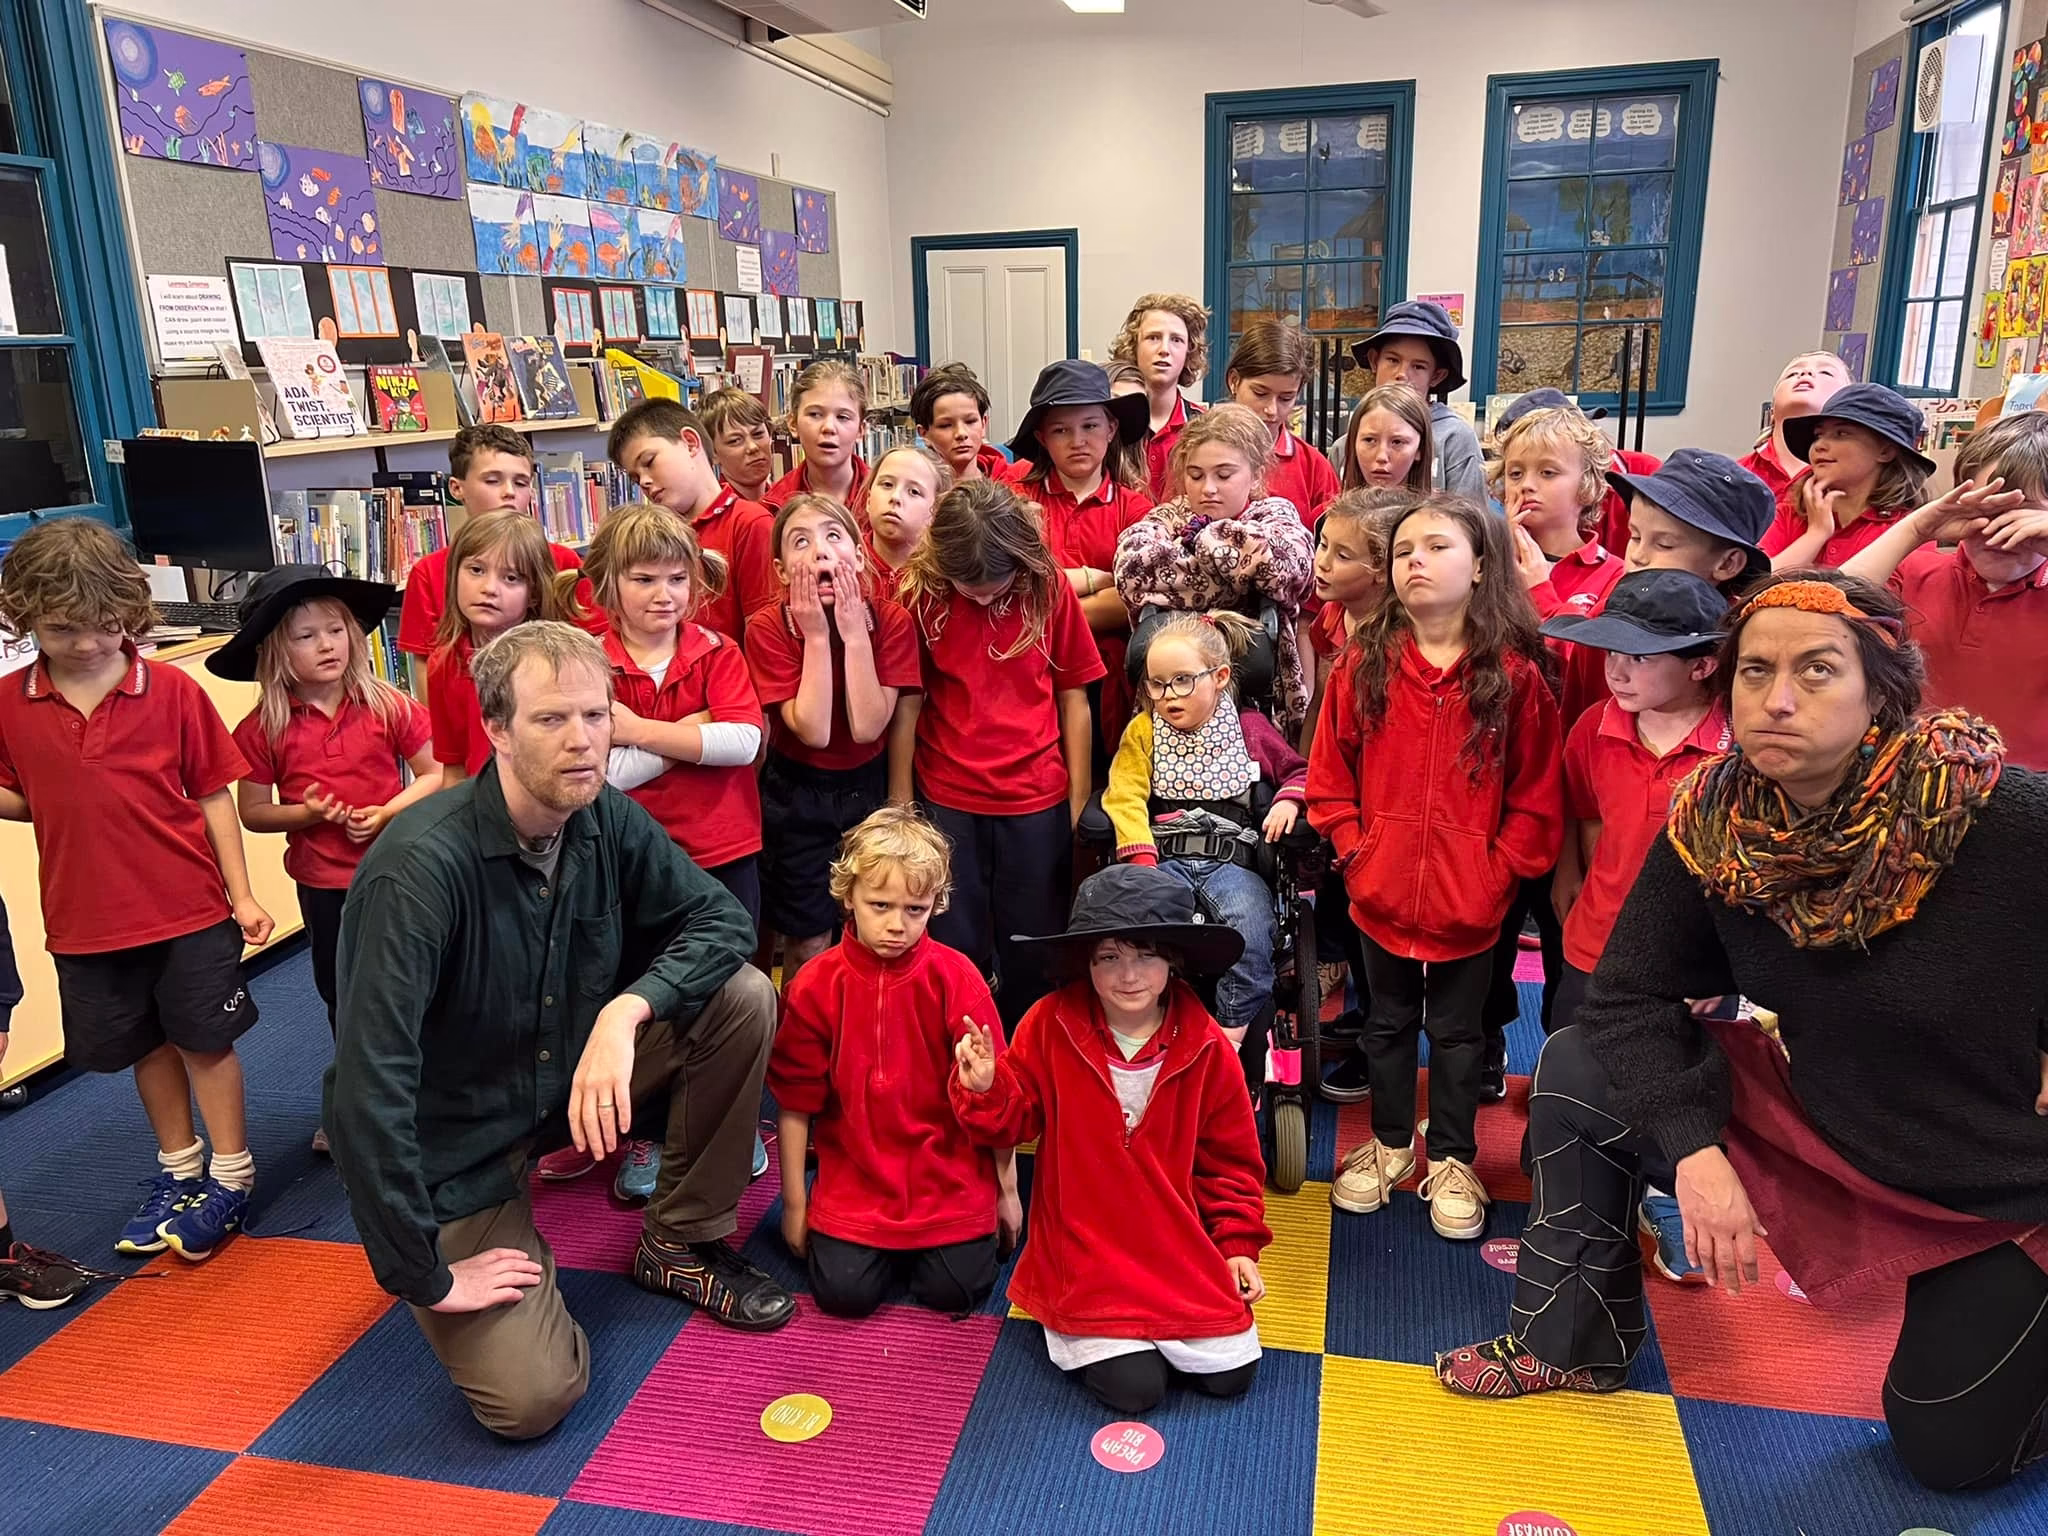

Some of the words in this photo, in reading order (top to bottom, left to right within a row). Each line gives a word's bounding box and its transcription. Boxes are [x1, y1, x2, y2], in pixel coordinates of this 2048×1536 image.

[375, 375, 420, 391] NINJA
[284, 386, 310, 399] ADA
[391, 387, 410, 398] KID
[287, 400, 330, 413] TWIST,
[294, 412, 355, 427] SCIENTIST
[768, 1403, 806, 1427] KIND
[799, 1411, 821, 1432] BE
[1120, 1428, 1147, 1448] BIG
[1100, 1437, 1146, 1466] DREAM
